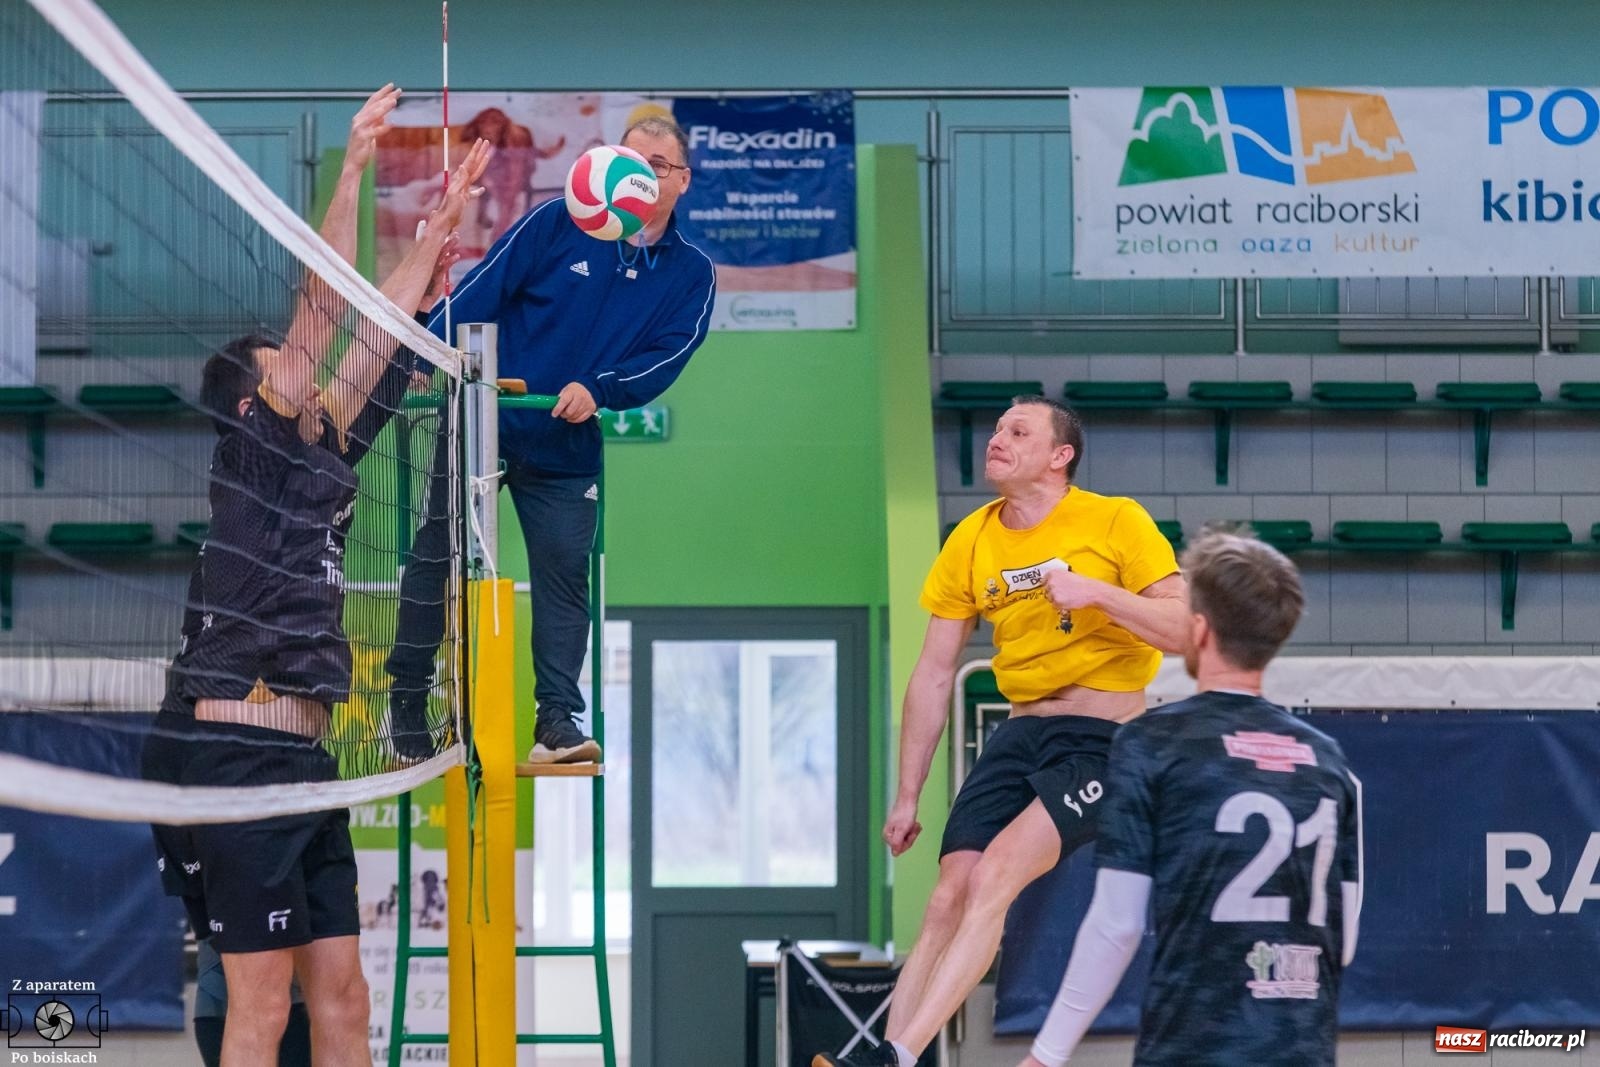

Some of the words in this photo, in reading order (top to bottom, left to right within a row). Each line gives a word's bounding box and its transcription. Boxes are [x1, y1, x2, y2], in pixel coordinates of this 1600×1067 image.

[1487, 89, 1600, 146] PO
[688, 126, 836, 152] Flexadin
[726, 190, 799, 206] Wsparcie
[1116, 195, 1232, 233] powiat
[1257, 194, 1419, 224] raciborski
[1116, 235, 1218, 255] zielona
[1241, 235, 1312, 254] oaza
[1334, 232, 1420, 252] kultur
[1011, 568, 1042, 584] DZIEŃ
[1210, 791, 1338, 927] 21
